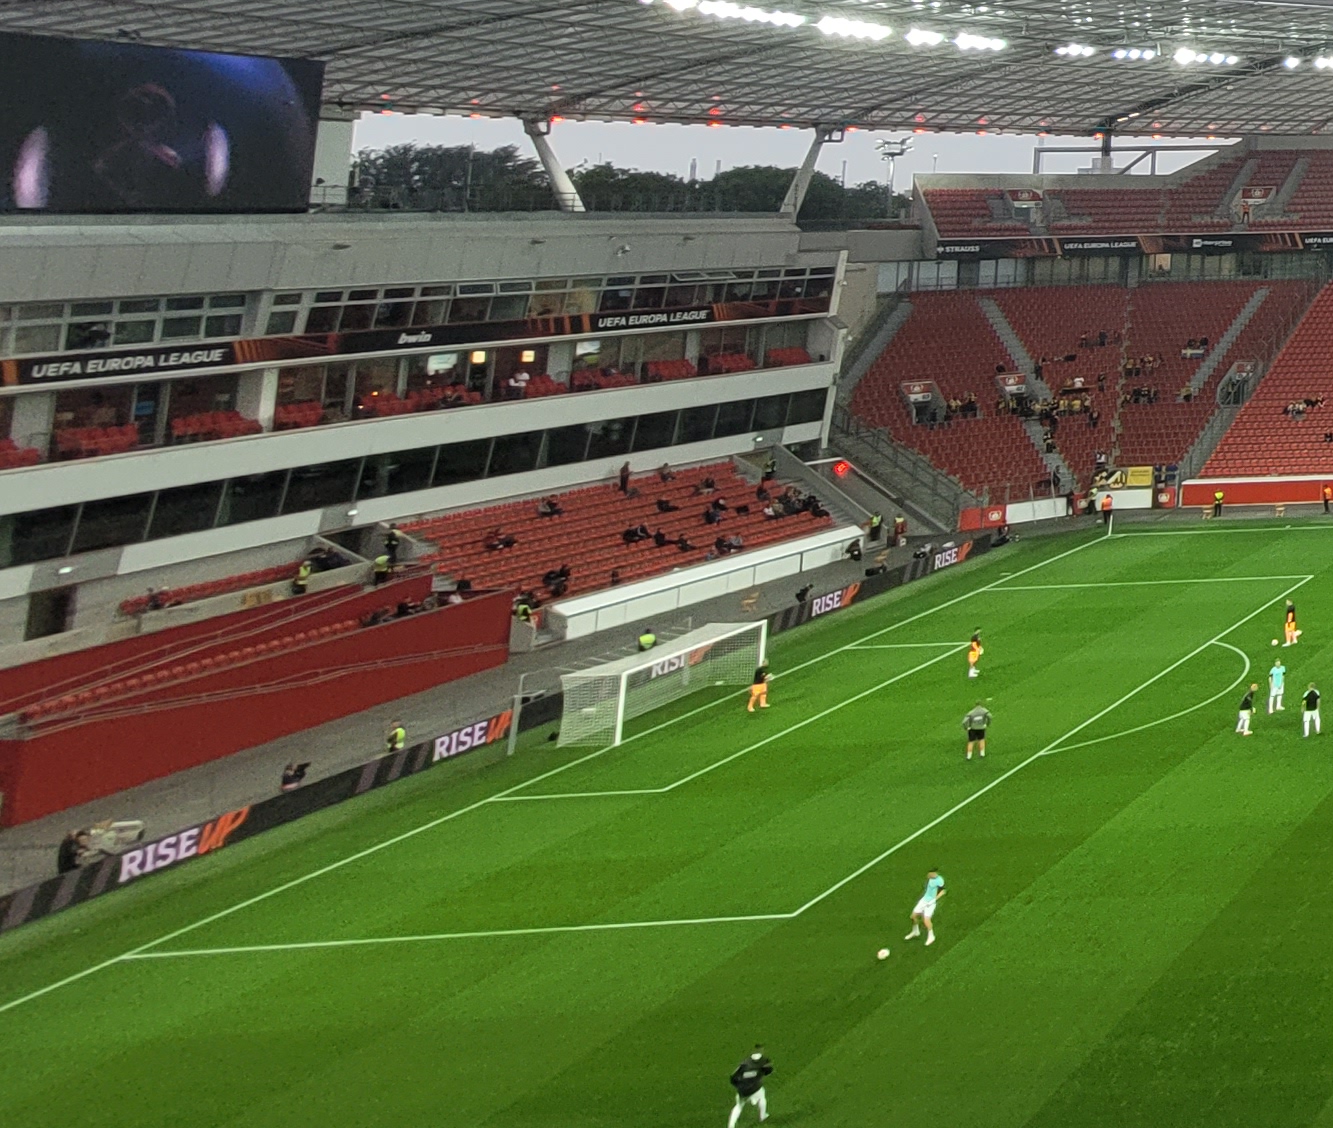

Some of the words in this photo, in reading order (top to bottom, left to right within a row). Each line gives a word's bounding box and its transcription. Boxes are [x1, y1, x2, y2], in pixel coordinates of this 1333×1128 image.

[598, 316, 626, 328] UEFA
[628, 313, 668, 326] EUROPA
[669, 310, 706, 322] LEAGUE
[32, 362, 82, 378] UEFA
[86, 355, 154, 373] EUROPA
[158, 348, 224, 367] LEAGUE
[934, 548, 959, 570] RISE
[811, 590, 842, 617] RISE
[432, 721, 489, 762] RISE
[118, 827, 200, 883] RISE
